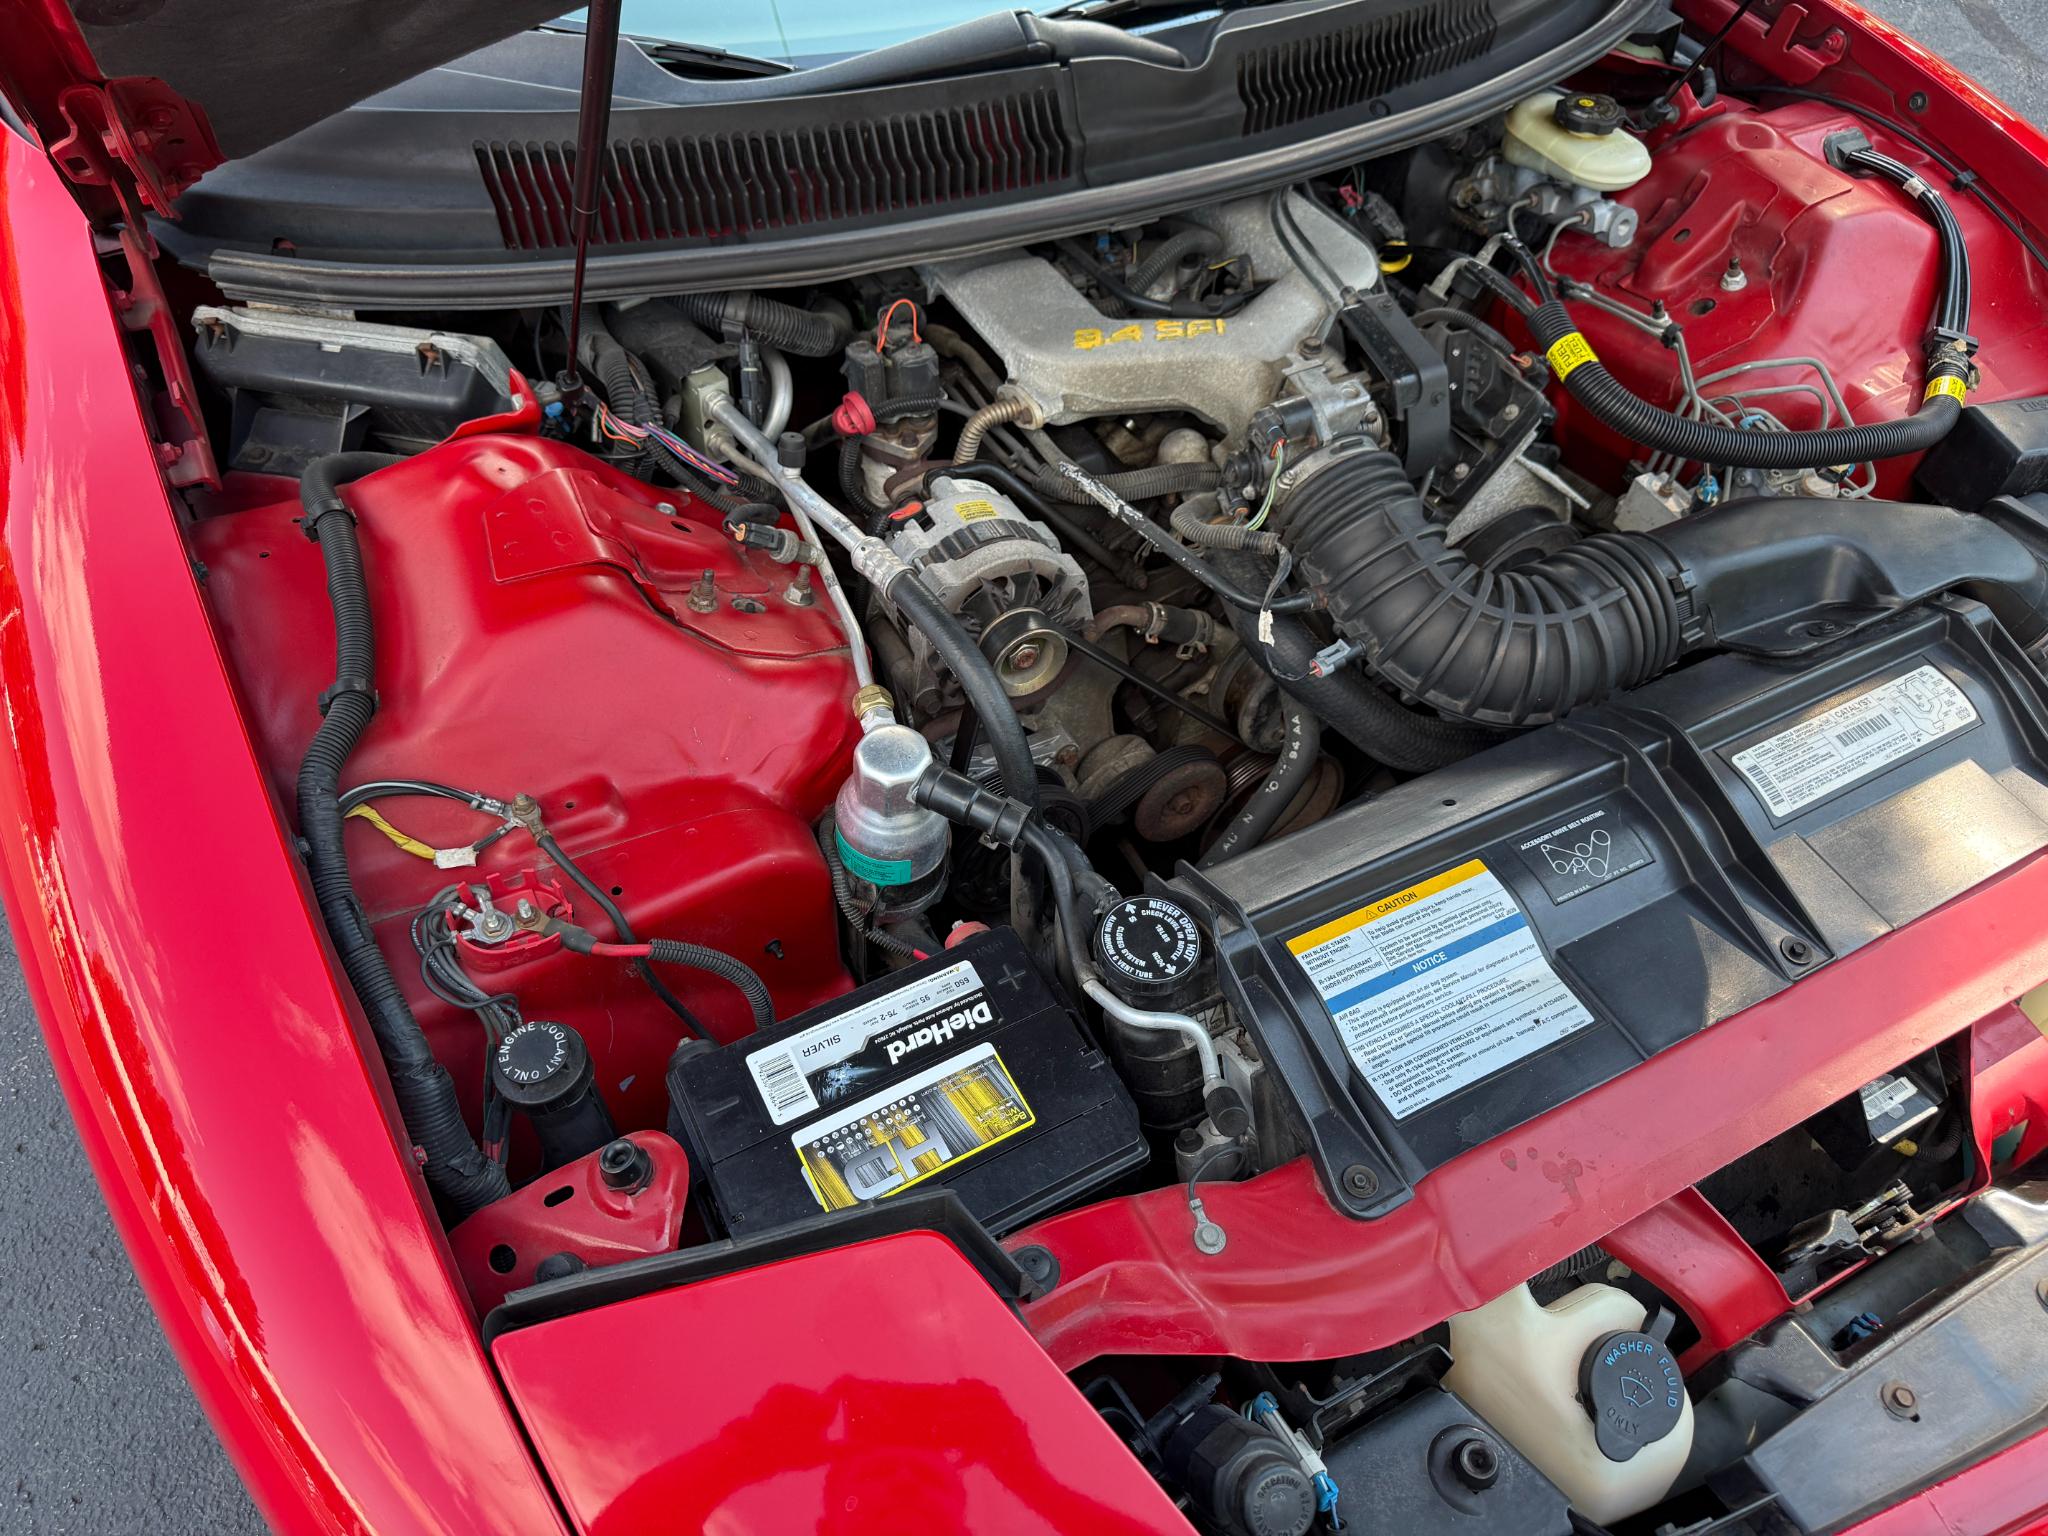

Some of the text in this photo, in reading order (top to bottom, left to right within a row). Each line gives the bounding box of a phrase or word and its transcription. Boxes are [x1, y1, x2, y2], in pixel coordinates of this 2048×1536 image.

[1154, 319, 1226, 341] SFI
[1556, 344, 1574, 368] FUEL
[1834, 697, 1872, 718] CATALYST
[1520, 809, 1605, 851] ACCESSORY DRIVE BELT ROUTING
[1141, 910, 1164, 919] CHECK
[1374, 925, 1387, 933] help
[1385, 919, 1399, 928] avoid
[1399, 910, 1421, 922] personal
[1434, 898, 1447, 907] keep
[1446, 892, 1461, 901] hands
[1376, 891, 1418, 914] CAUTION
[1104, 915, 1117, 932] ALIGN
[1149, 901, 1196, 961] NEVER OPEN HOT
[1164, 916, 1180, 931] LEVEL
[1371, 933, 1382, 941] Fan
[1381, 927, 1395, 936] blade
[1404, 918, 1416, 926] start
[1104, 933, 1116, 955] ARROW
[1116, 926, 1146, 967] CLOSED SYSTEM
[1171, 941, 1184, 960] BOTTLE
[1301, 935, 1351, 960] FAN BLADE STARTS
[1306, 944, 1350, 966] WITHOUT ENGINE
[1117, 960, 1134, 973] VENT
[1135, 970, 1153, 978] TUBE
[1318, 974, 1337, 985] R-134a
[1335, 957, 1374, 977] REFRIGERANT
[1411, 951, 1448, 973] NOTICE
[1322, 961, 1383, 991] UNDER HIGH PRESSURE
[1351, 1025, 1359, 1033] To
[1357, 1020, 1371, 1030] help
[1369, 1011, 1390, 1024] prevent
[1388, 1000, 1413, 1015] unwanted
[1441, 977, 1461, 990] Service
[1460, 969, 1479, 982] Manual
[1484, 955, 1510, 970] diagnostic
[1517, 943, 1536, 954] service
[879, 976, 970, 1022] 650 95 75-2
[959, 990, 983, 1005] Distributed
[1347, 1016, 1360, 1026] This
[1359, 1008, 1378, 1020] vehicle
[1382, 995, 1406, 1010] equipped
[1405, 990, 1417, 998] with
[1429, 979, 1441, 988] bag
[924, 1012, 936, 1021] Auto
[935, 1004, 953, 1016] Advance
[1338, 1008, 1361, 1021] AIR BAG
[1354, 1022, 1384, 1040] procedures
[1382, 1015, 1399, 1026] before
[1397, 1002, 1426, 1019] performing
[1424, 999, 1436, 1007] any
[499, 1021, 536, 1063] ENGINE
[886, 1001, 993, 1065] DieHard
[888, 1030, 896, 1038] NC
[1352, 1044, 1366, 1054] THIS
[1365, 1034, 1388, 1048] VEHICLE
[1387, 1021, 1415, 1038] REQUIRES
[1418, 1008, 1441, 1023] SPECIAL
[801, 1033, 842, 1058] SILVER
[1372, 1071, 1391, 1083] R-134a
[1403, 1059, 1415, 1068] AIR
[1413, 1042, 1450, 1063] CONDITIONED
[1448, 1030, 1475, 1046] VEHICLES
[1473, 1023, 1490, 1034] ONLY)
[1393, 1090, 1403, 1098] DO
[1402, 1084, 1414, 1093] NOT
[1413, 1073, 1437, 1088] INSTALL
[1436, 1068, 1447, 1077] R12
[1446, 1055, 1473, 1072] refrigerant
[1478, 1043, 1497, 1055] mineral
[1516, 1024, 1537, 1037] Damage
[1550, 1004, 1579, 1021] compressor
[503, 1066, 539, 1080] ONLY
[1394, 1072, 1421, 1089] equivalent
[1426, 1064, 1437, 1073] this
[1397, 1095, 1408, 1104] and
[1407, 1086, 1427, 1099] system
[1426, 1081, 1436, 1089] will
[844, 1120, 952, 1200] HD
[1604, 1341, 1678, 1408] WASHER FLUID
[1607, 1406, 1640, 1435] ONLY
